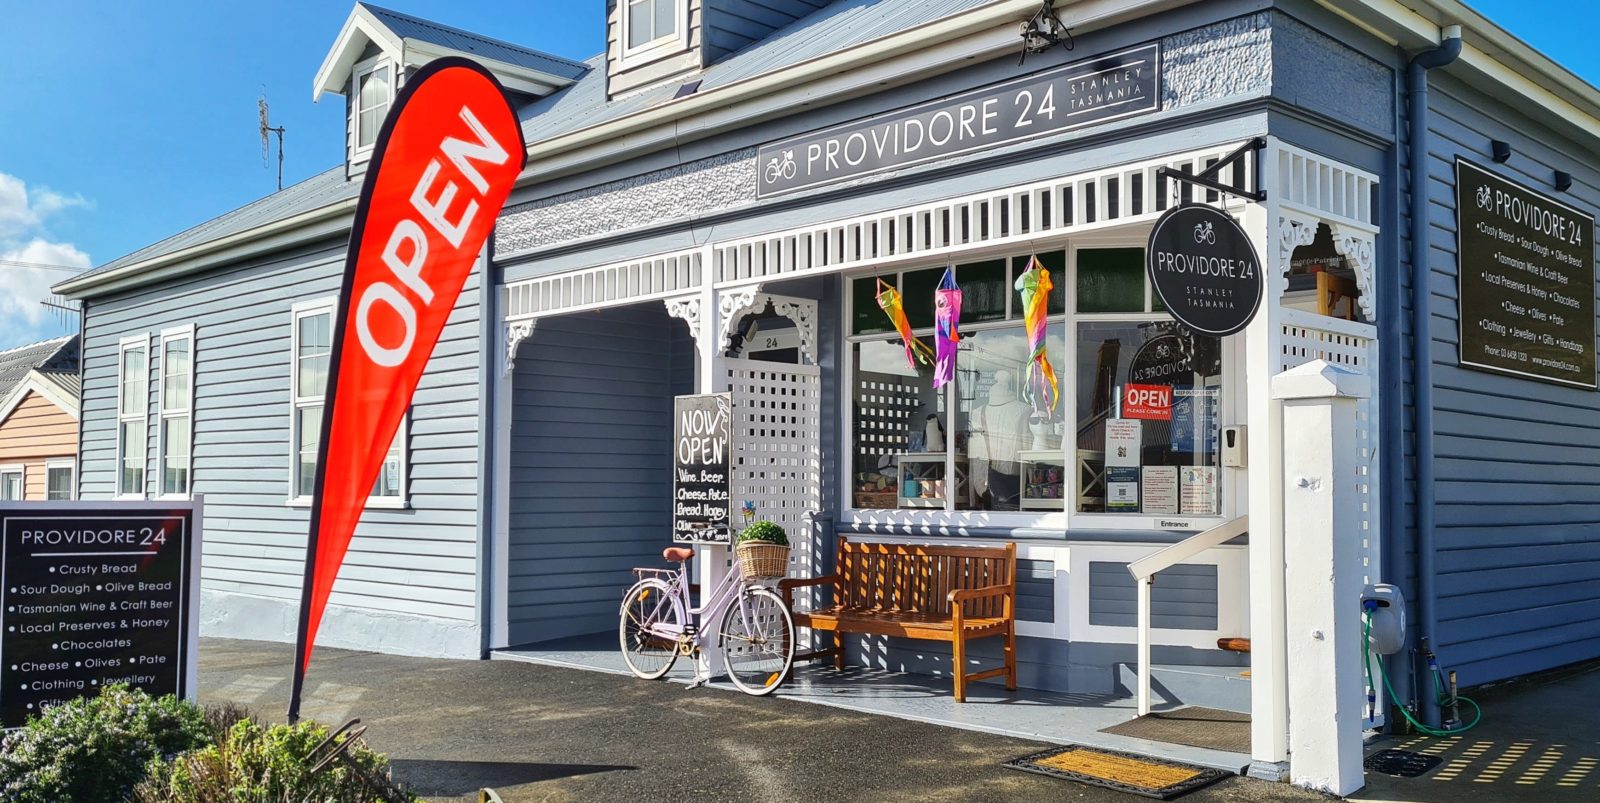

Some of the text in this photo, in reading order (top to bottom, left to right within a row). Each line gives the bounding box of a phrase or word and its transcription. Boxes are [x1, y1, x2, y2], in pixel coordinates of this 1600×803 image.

[1070, 66, 1143, 96] STANLEY
[1070, 84, 1142, 110] TASMANIA
[807, 83, 1056, 175] PROVIDORE 24
[1496, 190, 1582, 247] PROVIDORE 24
[356, 105, 510, 368] OPEN
[1480, 221, 1583, 268] Crusty Bread Sour Dough Olive Bread
[1158, 251, 1254, 280] PROVIDORE 24
[1497, 251, 1569, 285] Tasmanian Wine & Craft Beer
[1186, 285, 1233, 297] STANLEY
[1485, 269, 1580, 309] Local Preserves & Honey Chocolates
[1187, 298, 1235, 309] TASMANIA
[1505, 300, 1565, 326] Cheese Olives Pate
[766, 338, 778, 348] 24
[1482, 319, 1584, 354] Clothing Jewellery Gifts Handbags
[1127, 389, 1169, 408] OPEN
[681, 409, 721, 436] NOW
[679, 436, 723, 465] OPEN
[1160, 520, 1189, 528] Entrance
[21, 527, 167, 546] PROVIDORE 24
[59, 563, 137, 576] Crusty Bread
[20, 581, 172, 596] Sour Dough Olive Bread
[17, 600, 173, 614] Tasmanian Wine & Craft Beer
[20, 618, 170, 633] Local Preserves & Honey
[61, 638, 131, 651] Chocolates
[21, 654, 167, 672] Cheese Olives Pate
[31, 674, 155, 690] Clothing Jewellery
